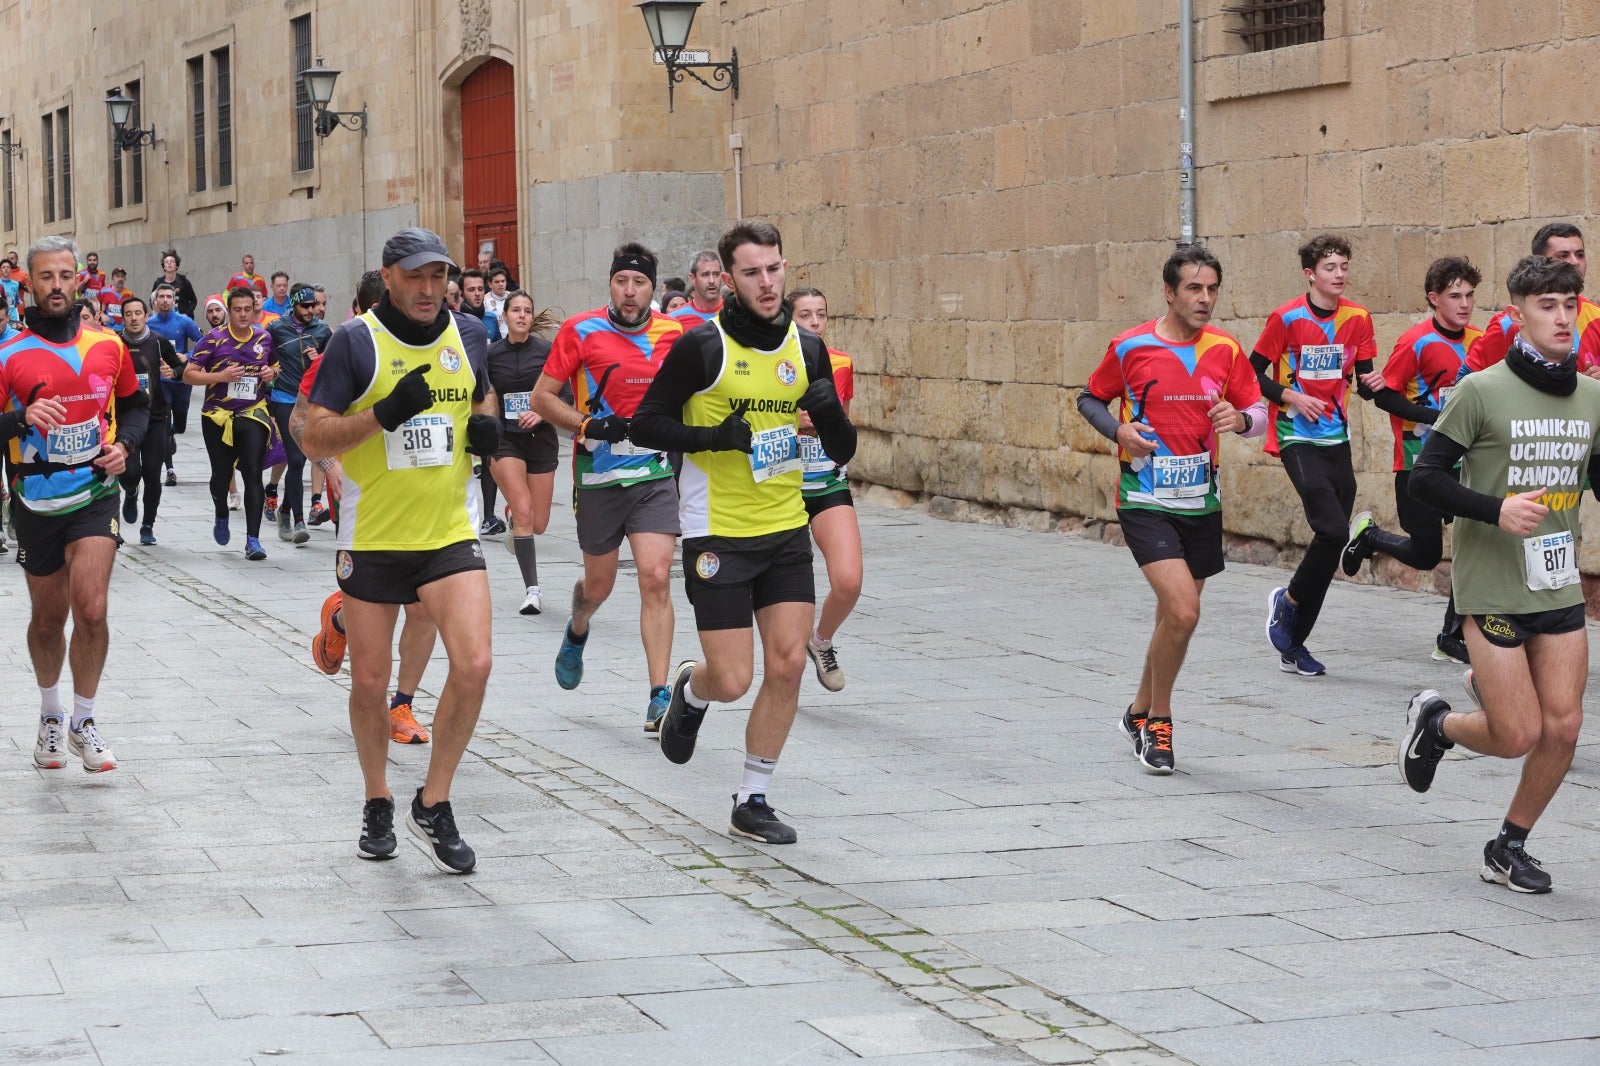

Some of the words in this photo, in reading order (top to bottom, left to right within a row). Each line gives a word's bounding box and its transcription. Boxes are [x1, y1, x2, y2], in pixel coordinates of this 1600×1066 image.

[1307, 353, 1333, 368] 3747
[234, 382, 250, 392] 1775
[430, 388, 468, 403] RUELA
[728, 398, 798, 414] VILORUELA
[62, 420, 96, 435] SETEL
[403, 416, 447, 428] SETEL
[1510, 418, 1590, 439] KUMIKATA
[54, 432, 91, 451] 4862
[403, 428, 432, 451] 318
[761, 428, 793, 442] SETEL
[757, 438, 791, 465] 4359
[802, 444, 826, 460] 092
[1170, 456, 1205, 466] SETEL
[1162, 465, 1199, 485] 3737
[1542, 534, 1573, 548] SETE
[1543, 547, 1566, 572] 817
